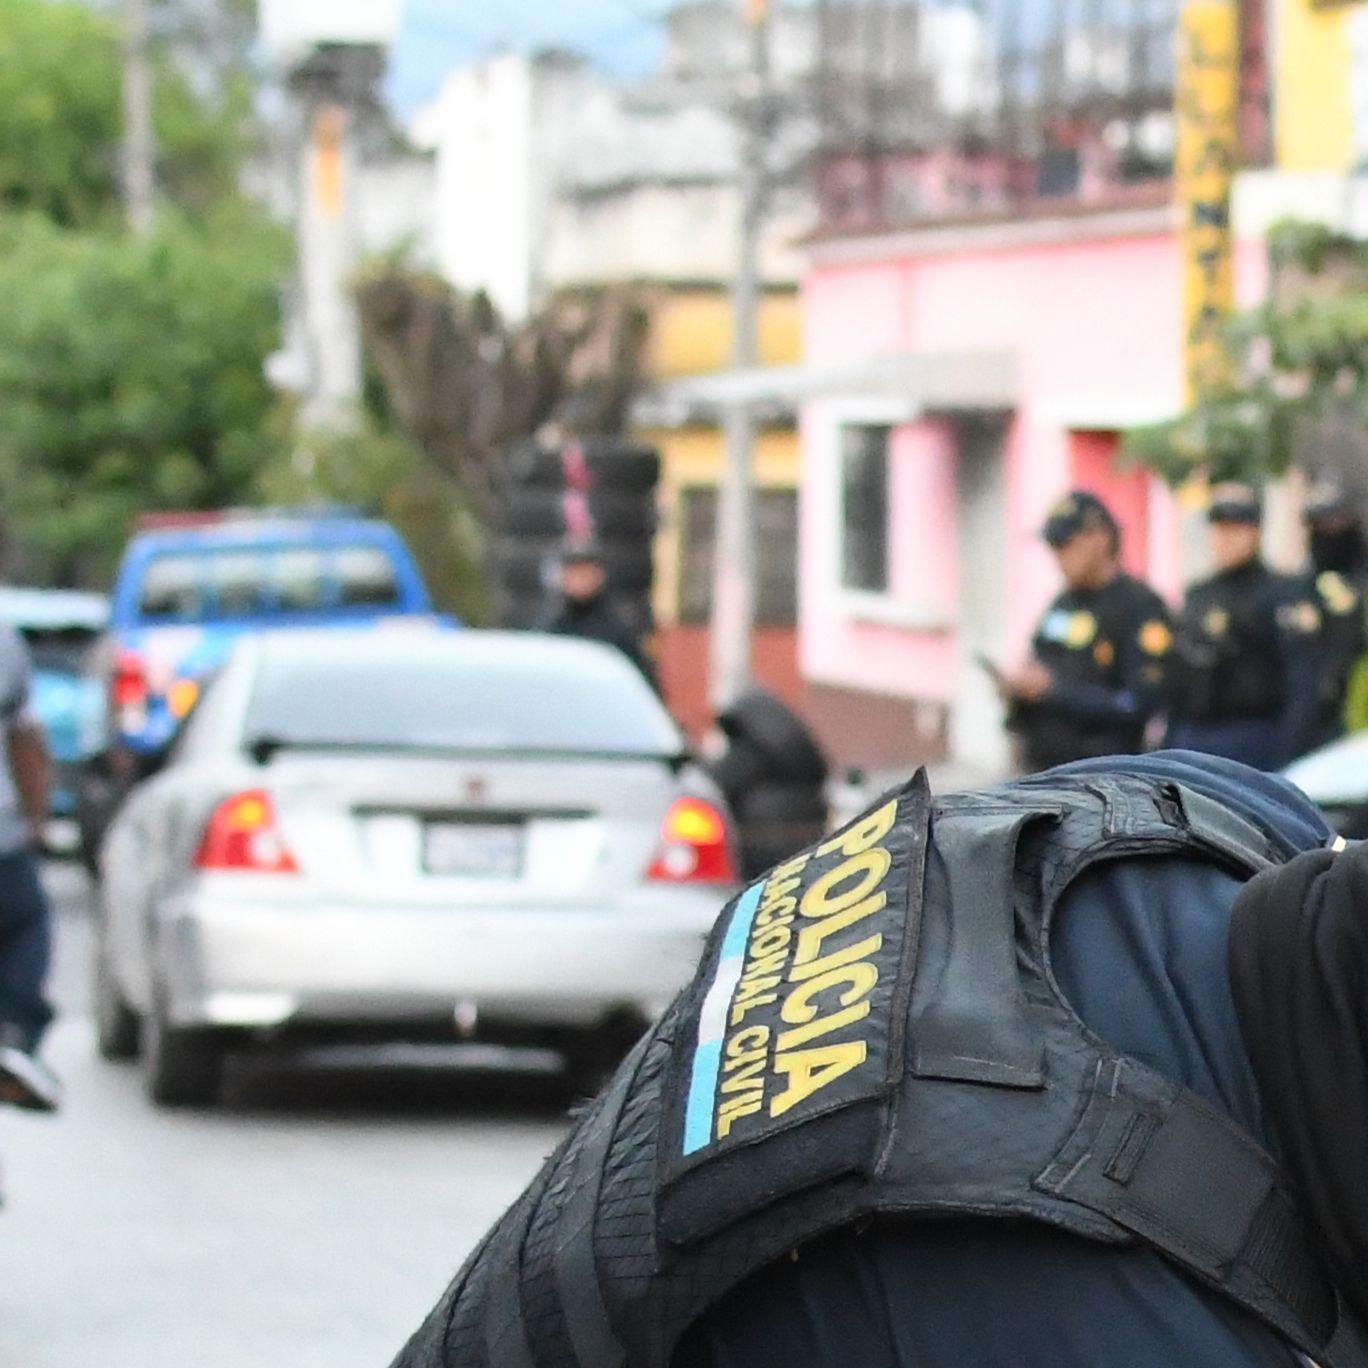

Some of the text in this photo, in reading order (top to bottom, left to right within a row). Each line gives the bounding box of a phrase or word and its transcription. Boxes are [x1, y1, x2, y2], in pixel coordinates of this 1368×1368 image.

[716, 852, 811, 1141] NACIONAL CIVIL
[769, 798, 898, 1119] POLICIA
